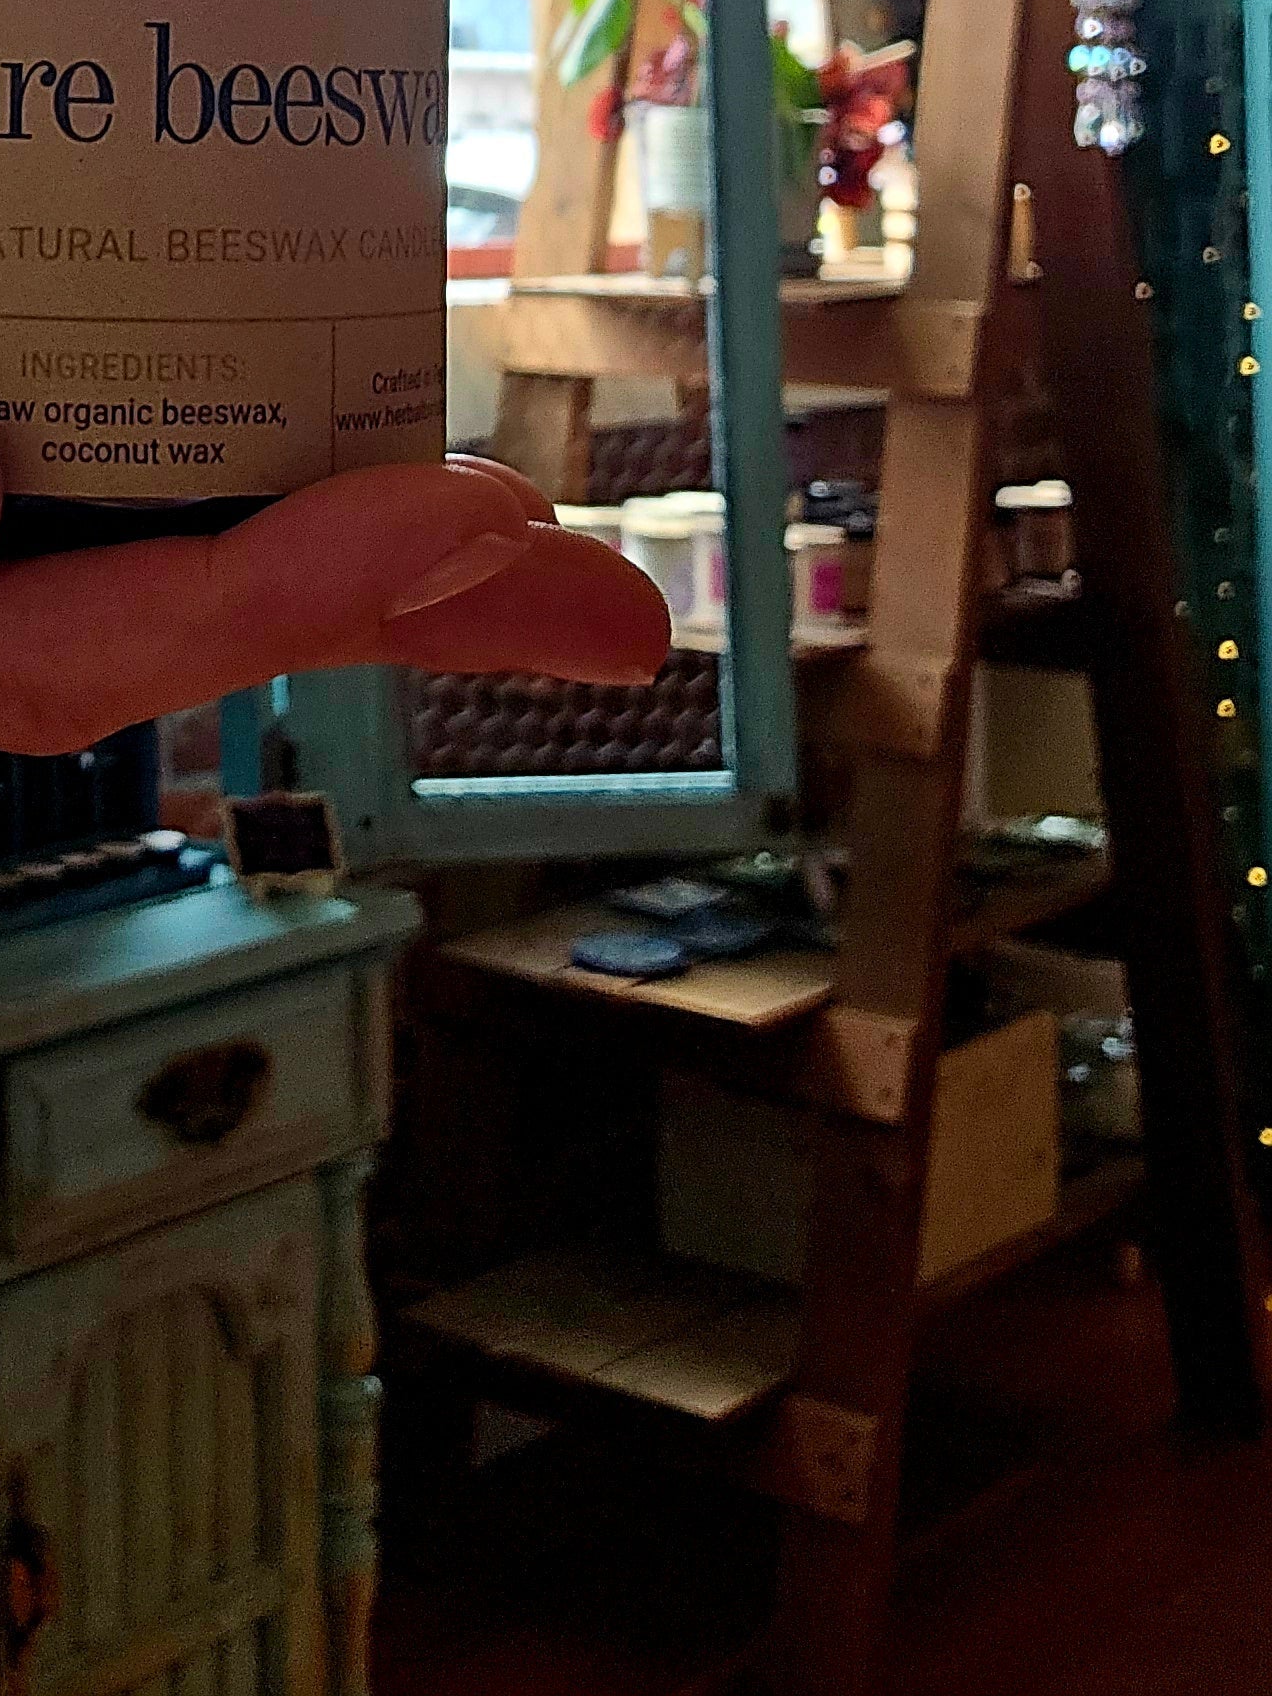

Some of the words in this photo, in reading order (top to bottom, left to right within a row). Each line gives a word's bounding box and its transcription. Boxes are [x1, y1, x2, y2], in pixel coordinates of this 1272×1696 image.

[167, 227, 347, 264] BEESWAX
[20, 353, 245, 383] INGREDIENTS:
[44, 397, 152, 431] organic
[162, 398, 288, 428] beeswax,
[41, 439, 160, 465] coconut
[168, 442, 226, 464] wax
